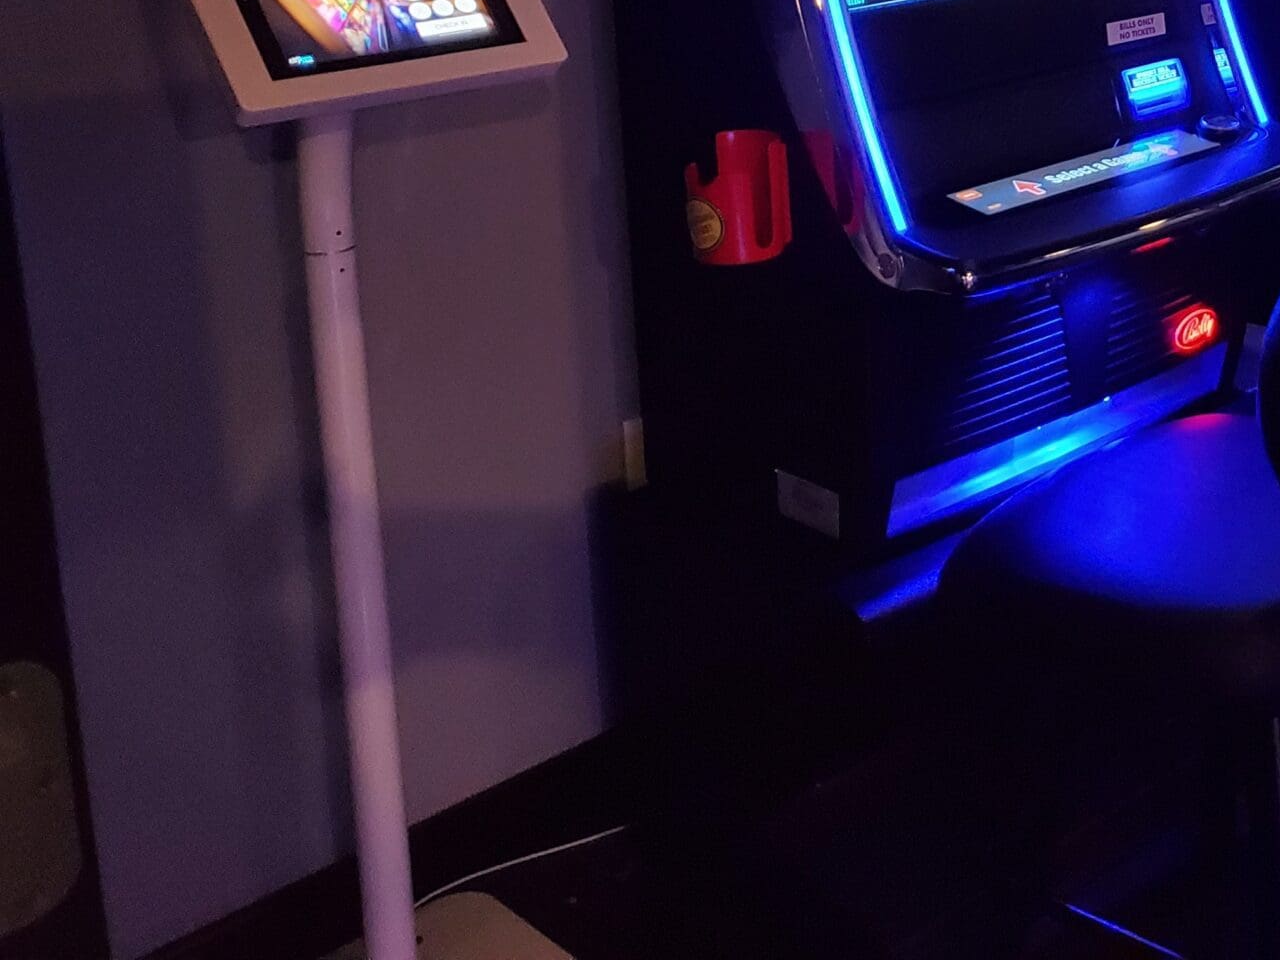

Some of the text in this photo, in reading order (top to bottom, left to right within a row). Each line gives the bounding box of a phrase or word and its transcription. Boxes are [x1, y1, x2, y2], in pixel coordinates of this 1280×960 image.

[1119, 17, 1155, 31] BILLS ONLY
[1120, 26, 1156, 40] NO TICKETS
[1044, 165, 1092, 183] Select
